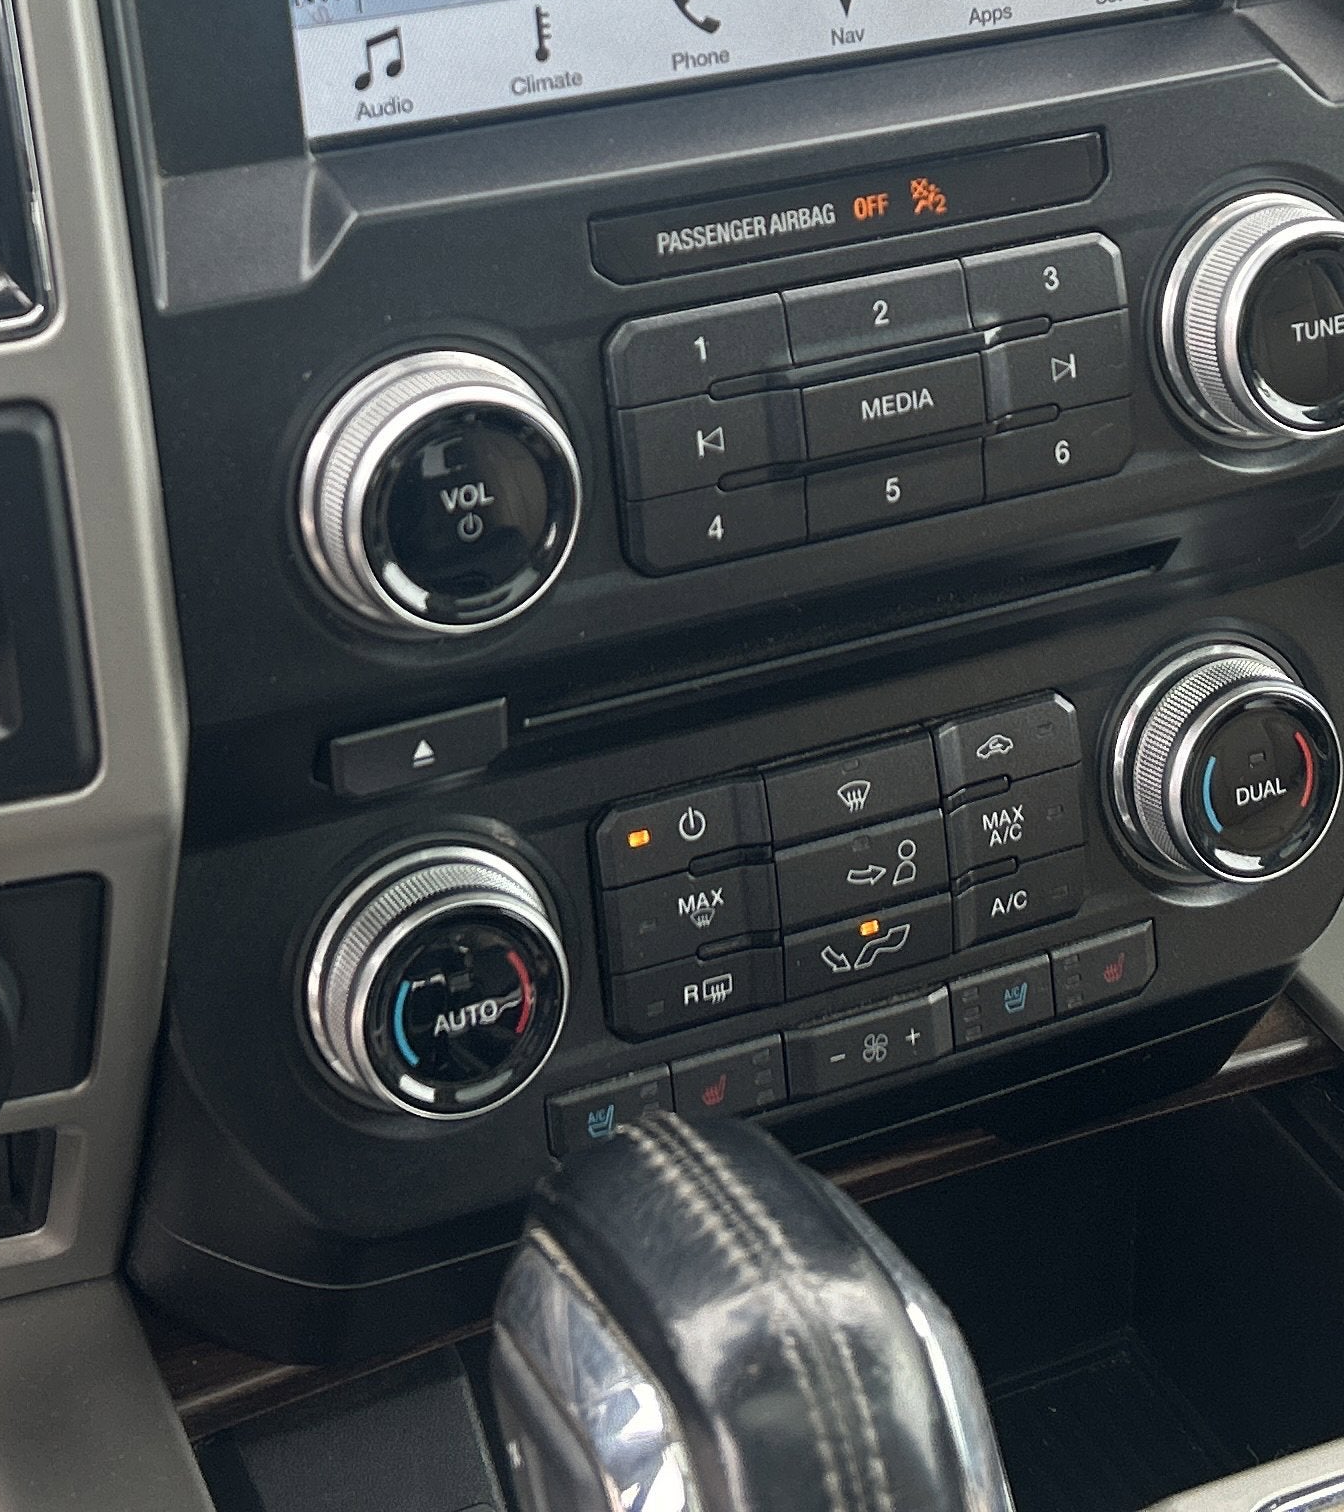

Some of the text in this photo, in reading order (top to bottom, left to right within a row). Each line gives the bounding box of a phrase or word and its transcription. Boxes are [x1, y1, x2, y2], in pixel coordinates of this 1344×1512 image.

[968, 6, 1014, 27] Apps
[830, 27, 866, 47] Nav
[671, 49, 731, 71] Phone
[510, 70, 584, 96] Climate
[356, 96, 415, 121] Audio
[656, 192, 890, 256] PASSENGER AIRBAG OFF
[1042, 265, 1060, 291] 3
[872, 299, 891, 326] 2
[693, 335, 709, 362] 1
[861, 387, 935, 421] MEDIA
[1054, 439, 1071, 465] 6
[439, 481, 496, 514] VOL
[885, 477, 902, 504] 5
[707, 514, 725, 541] 4
[1235, 777, 1288, 807] DUAL
[981, 804, 1026, 832] MAX
[988, 823, 1023, 847] A/C
[677, 887, 725, 916] MAX
[990, 890, 1029, 917] A/C
[683, 984, 699, 1006] R
[433, 999, 499, 1037] AUTO
